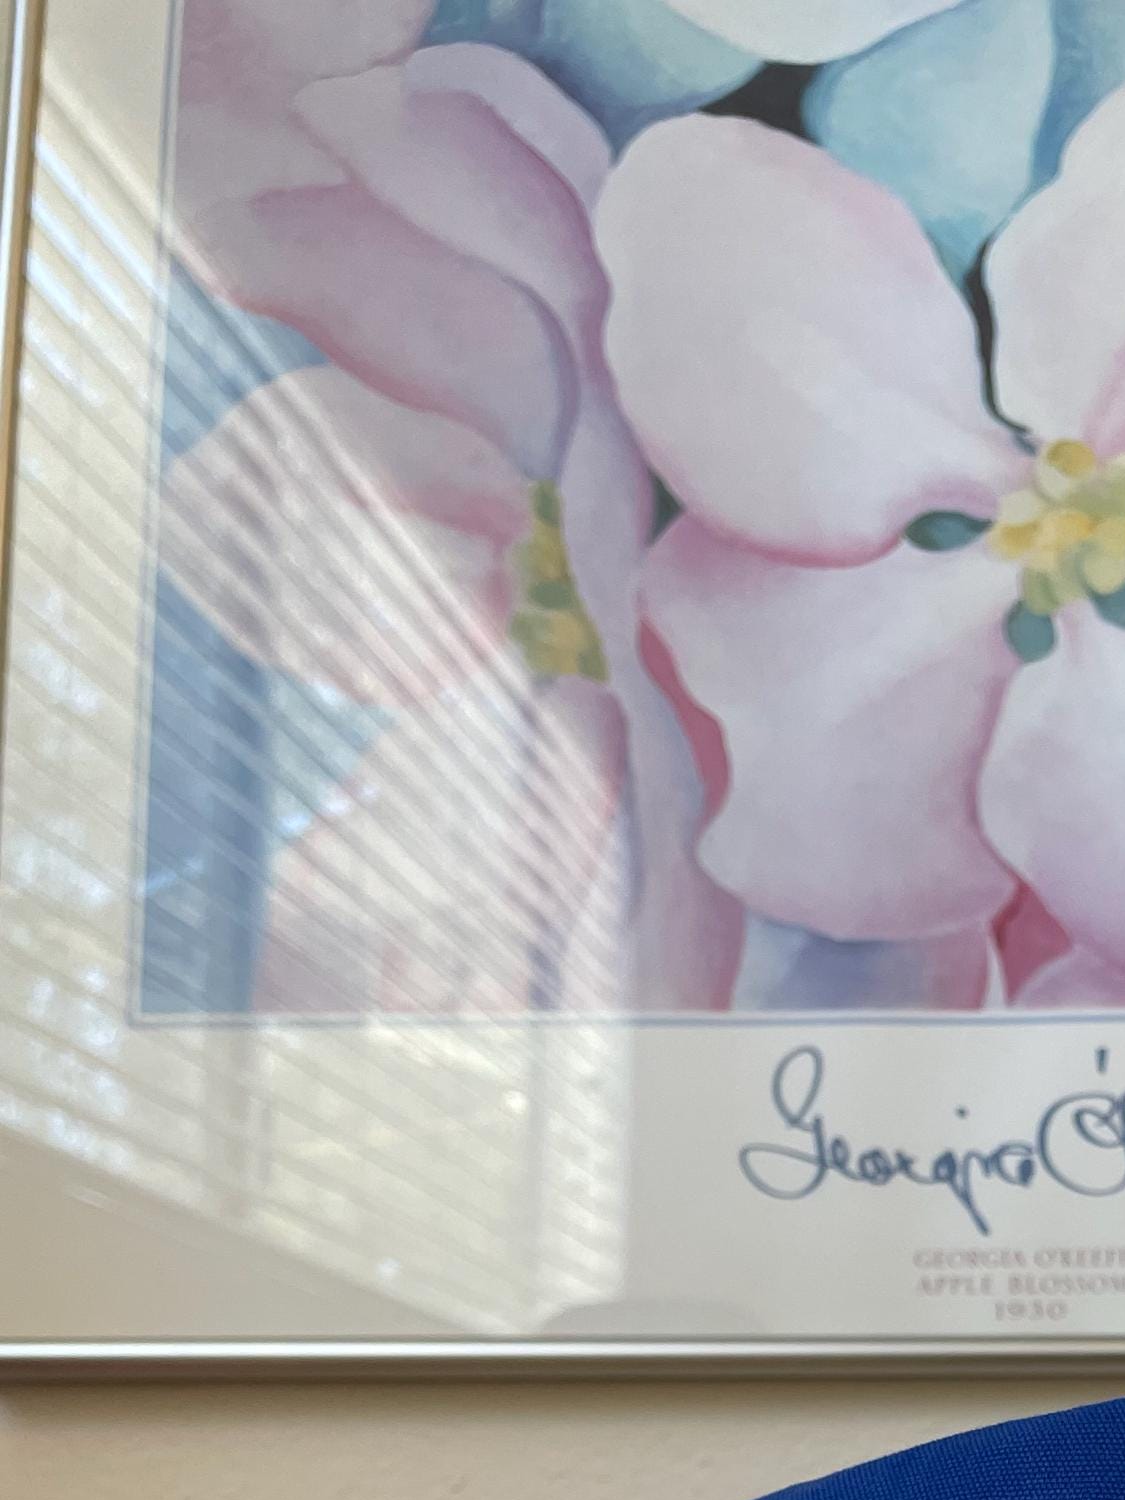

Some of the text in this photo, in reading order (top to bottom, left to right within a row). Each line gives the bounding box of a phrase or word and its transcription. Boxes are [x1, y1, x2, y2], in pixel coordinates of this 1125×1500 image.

[739, 1044, 1035, 1236] Georgia
[912, 1248, 1027, 1269] GEORGIA
[916, 1275, 995, 1296] APPLE
[995, 1301, 1069, 1321] 1930
